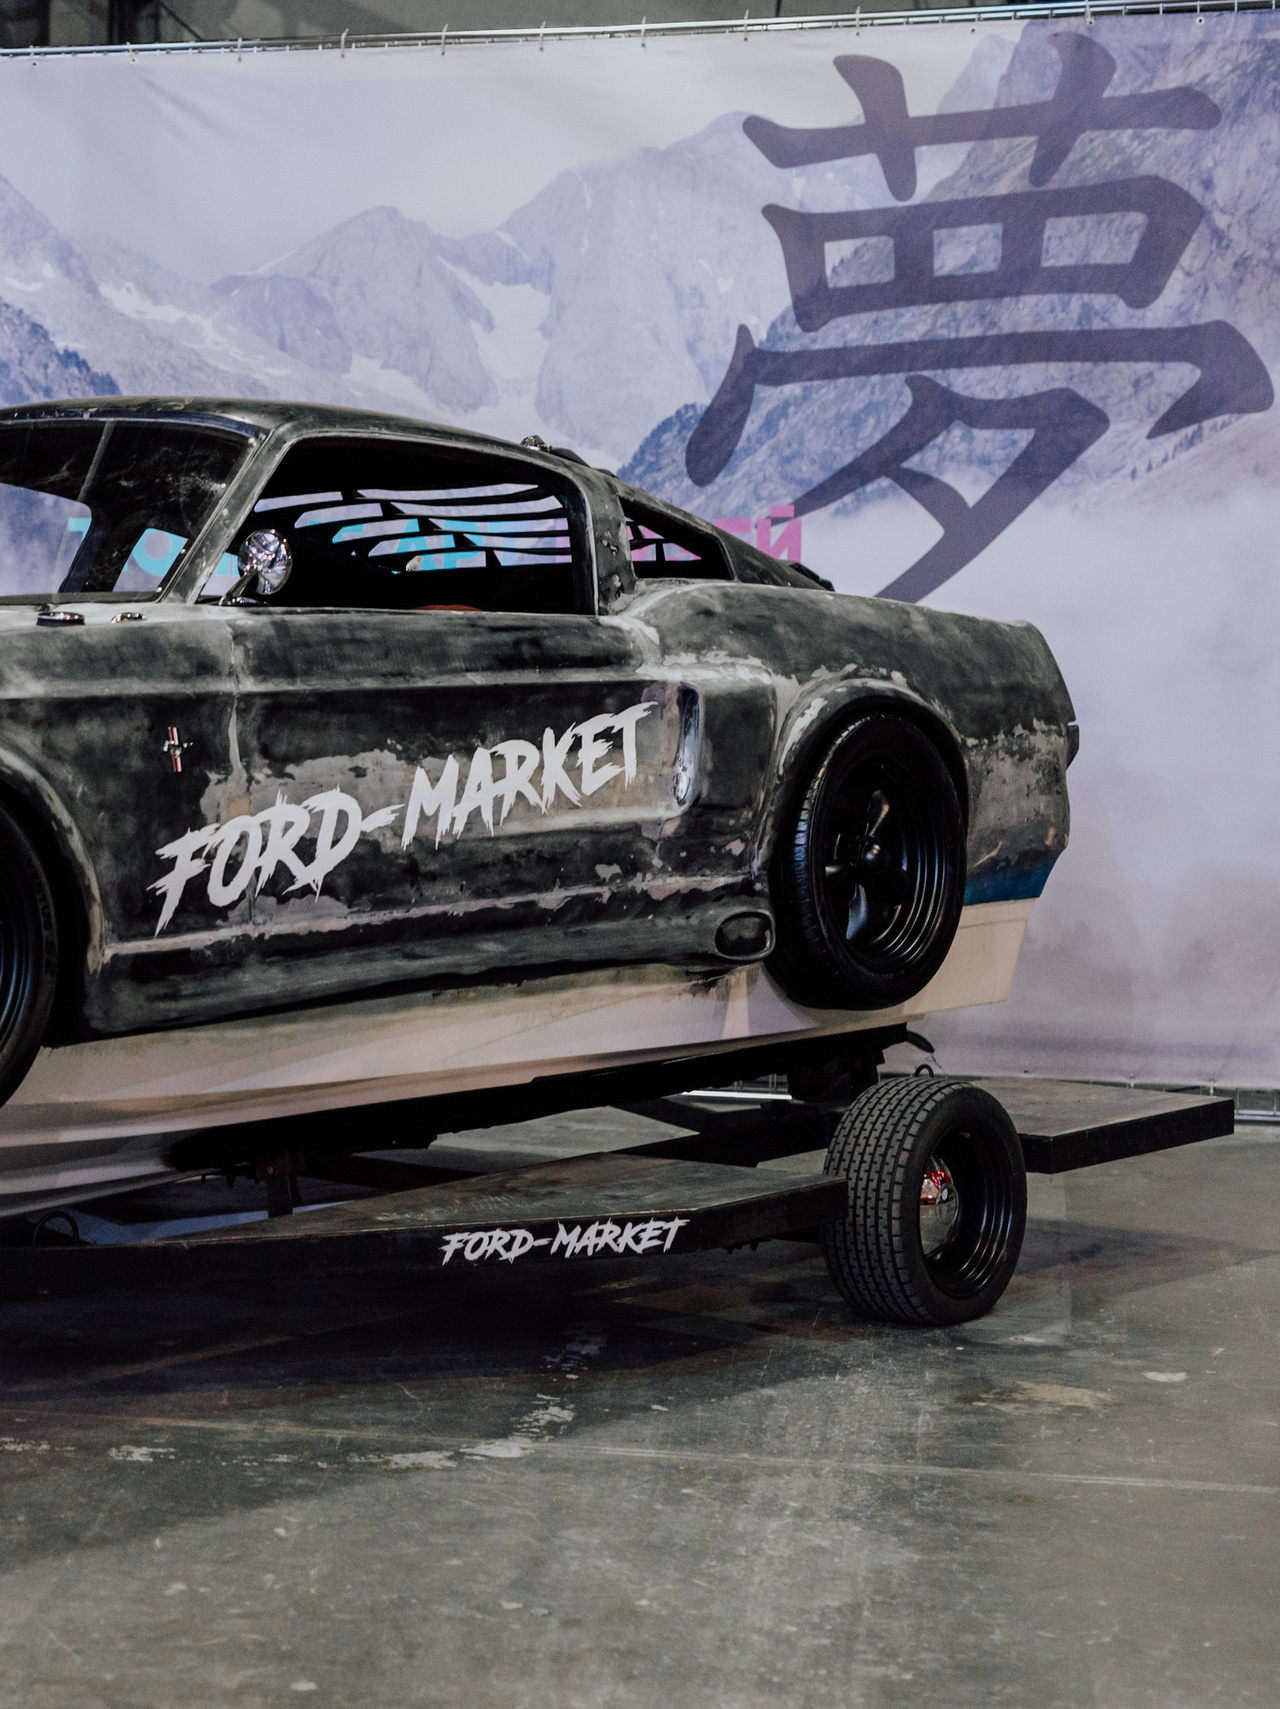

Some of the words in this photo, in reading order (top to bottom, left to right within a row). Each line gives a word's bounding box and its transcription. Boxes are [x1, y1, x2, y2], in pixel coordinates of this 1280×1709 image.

[685, 31, 1275, 604] 夢
[148, 701, 658, 936] FORD-MARKET
[439, 1216, 690, 1266] FORD-MARKET
